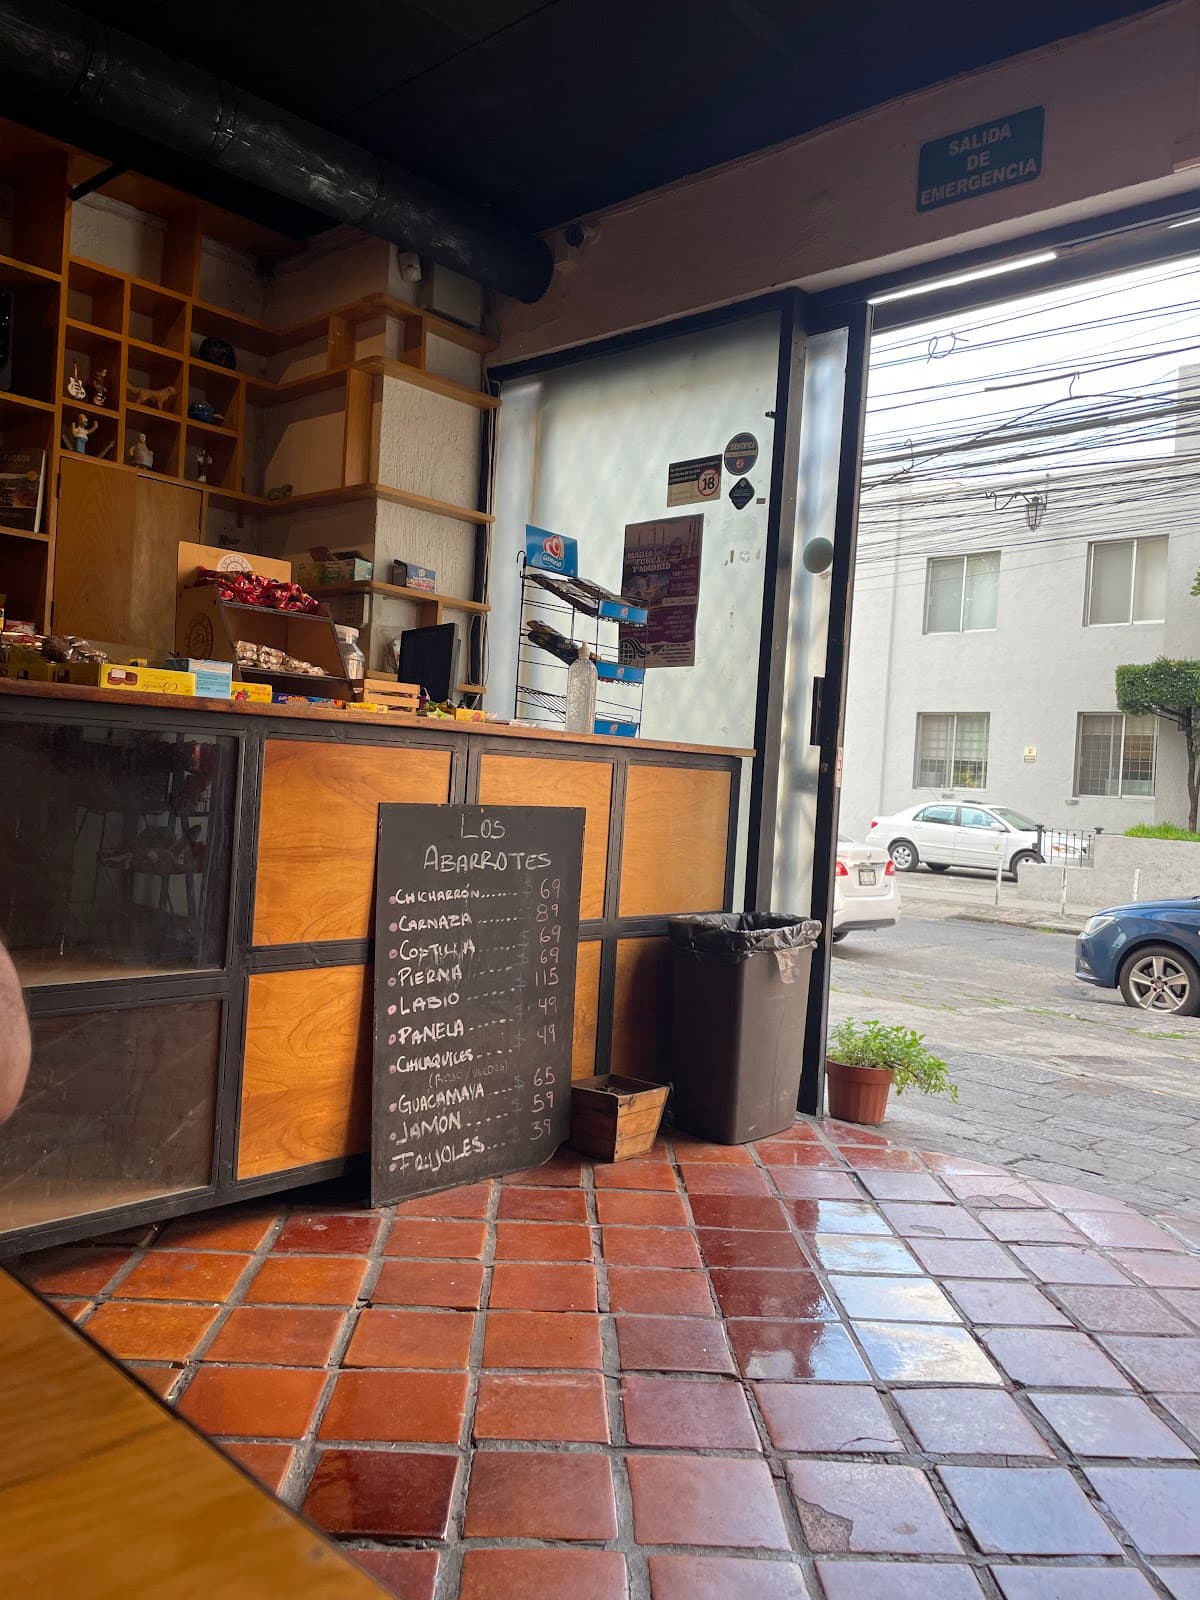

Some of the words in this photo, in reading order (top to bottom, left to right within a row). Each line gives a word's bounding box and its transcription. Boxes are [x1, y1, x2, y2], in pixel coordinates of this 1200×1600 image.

[948, 123, 1012, 156] SALIDA
[967, 150, 990, 170] DE
[920, 158, 1037, 205] EMERGENCIA
[702, 477, 714, 490] 18
[460, 813, 505, 839] LOS
[423, 845, 551, 873] ABARROTES
[540, 878, 561, 899] 69
[399, 913, 472, 932] CARNAZA
[536, 903, 559, 922] 89
[539, 925, 561, 944] 69
[398, 965, 463, 987] PIERNA
[540, 947, 560, 965] 69
[535, 967, 559, 986] 115
[397, 1018, 464, 1045] PANELA
[538, 996, 557, 1015] 49
[536, 1024, 556, 1045] 49
[398, 1083, 485, 1115] GUACAMAYA
[533, 1067, 556, 1087] 65
[531, 1091, 554, 1113] 59
[529, 1119, 551, 1141] 39
